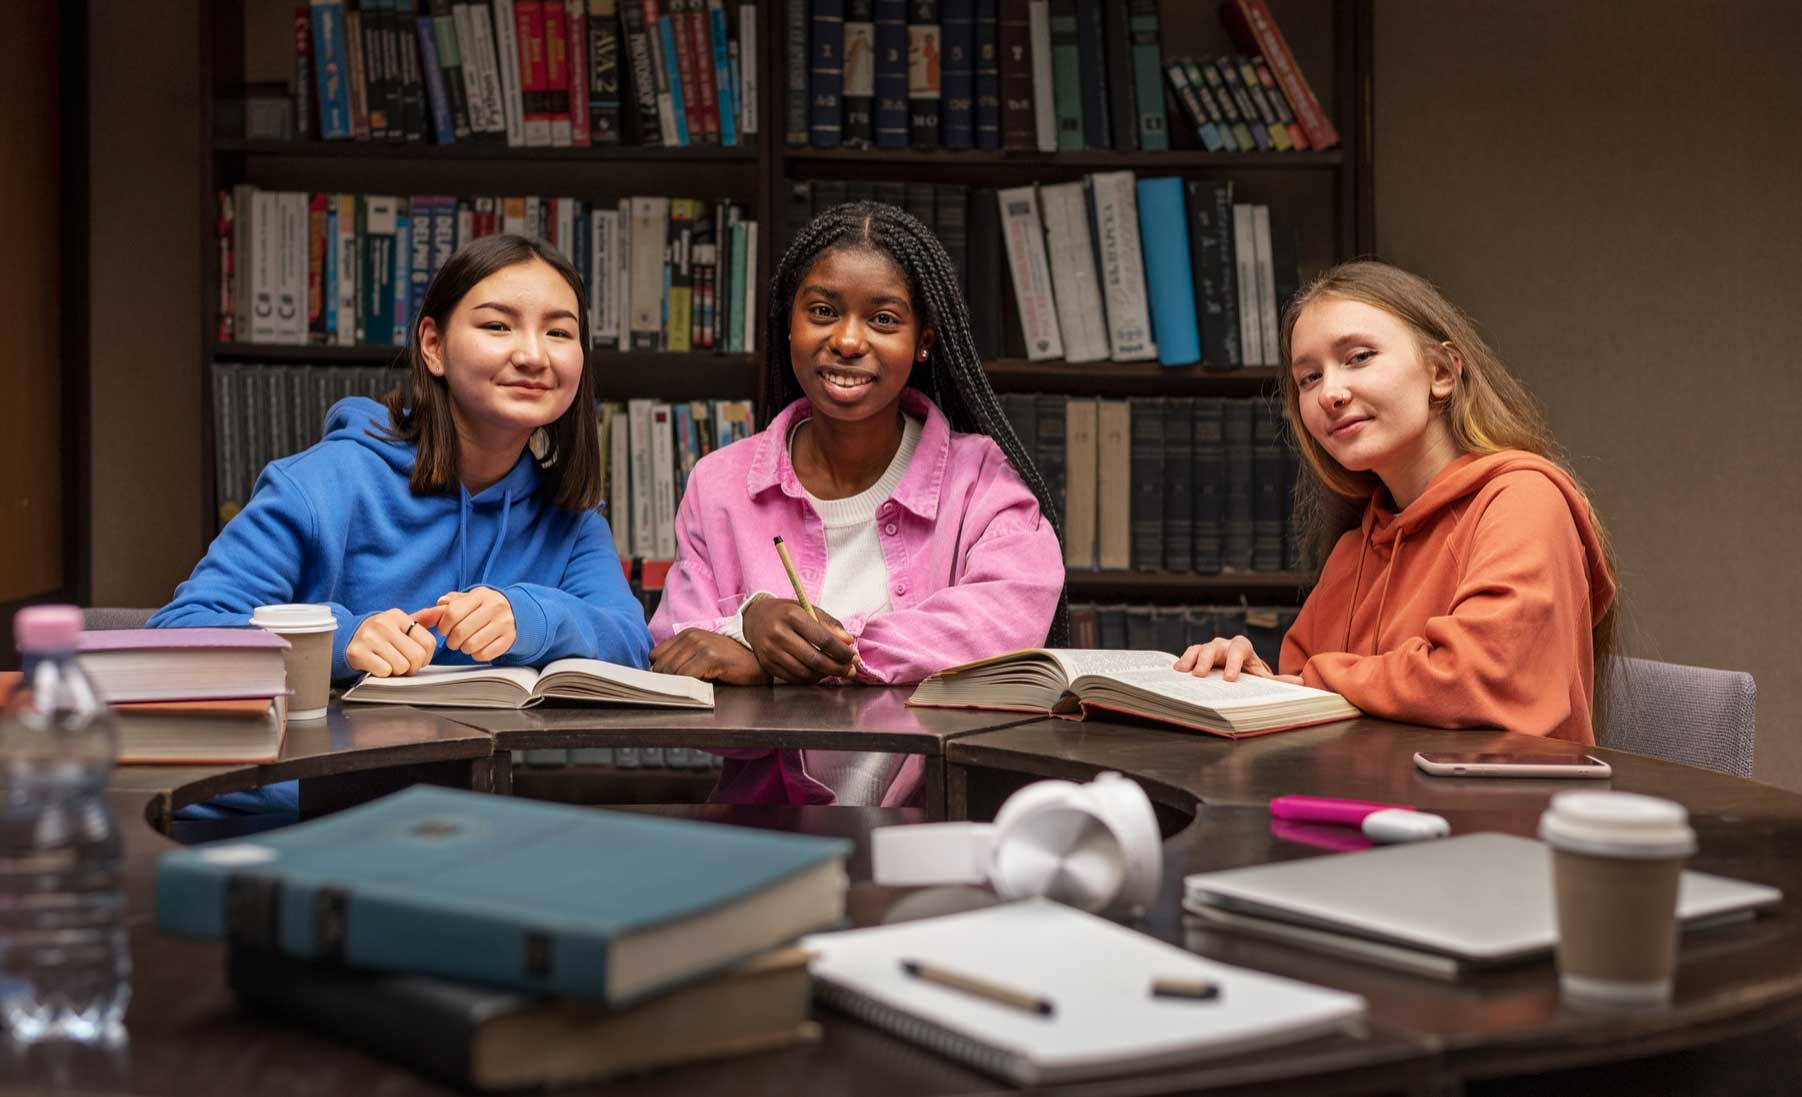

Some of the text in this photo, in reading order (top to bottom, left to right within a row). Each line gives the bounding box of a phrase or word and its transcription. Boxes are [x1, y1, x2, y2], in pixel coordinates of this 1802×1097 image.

[412, 216, 430, 269] DELPHI
[255, 292, 272, 318] C#
[277, 293, 295, 320] C#
